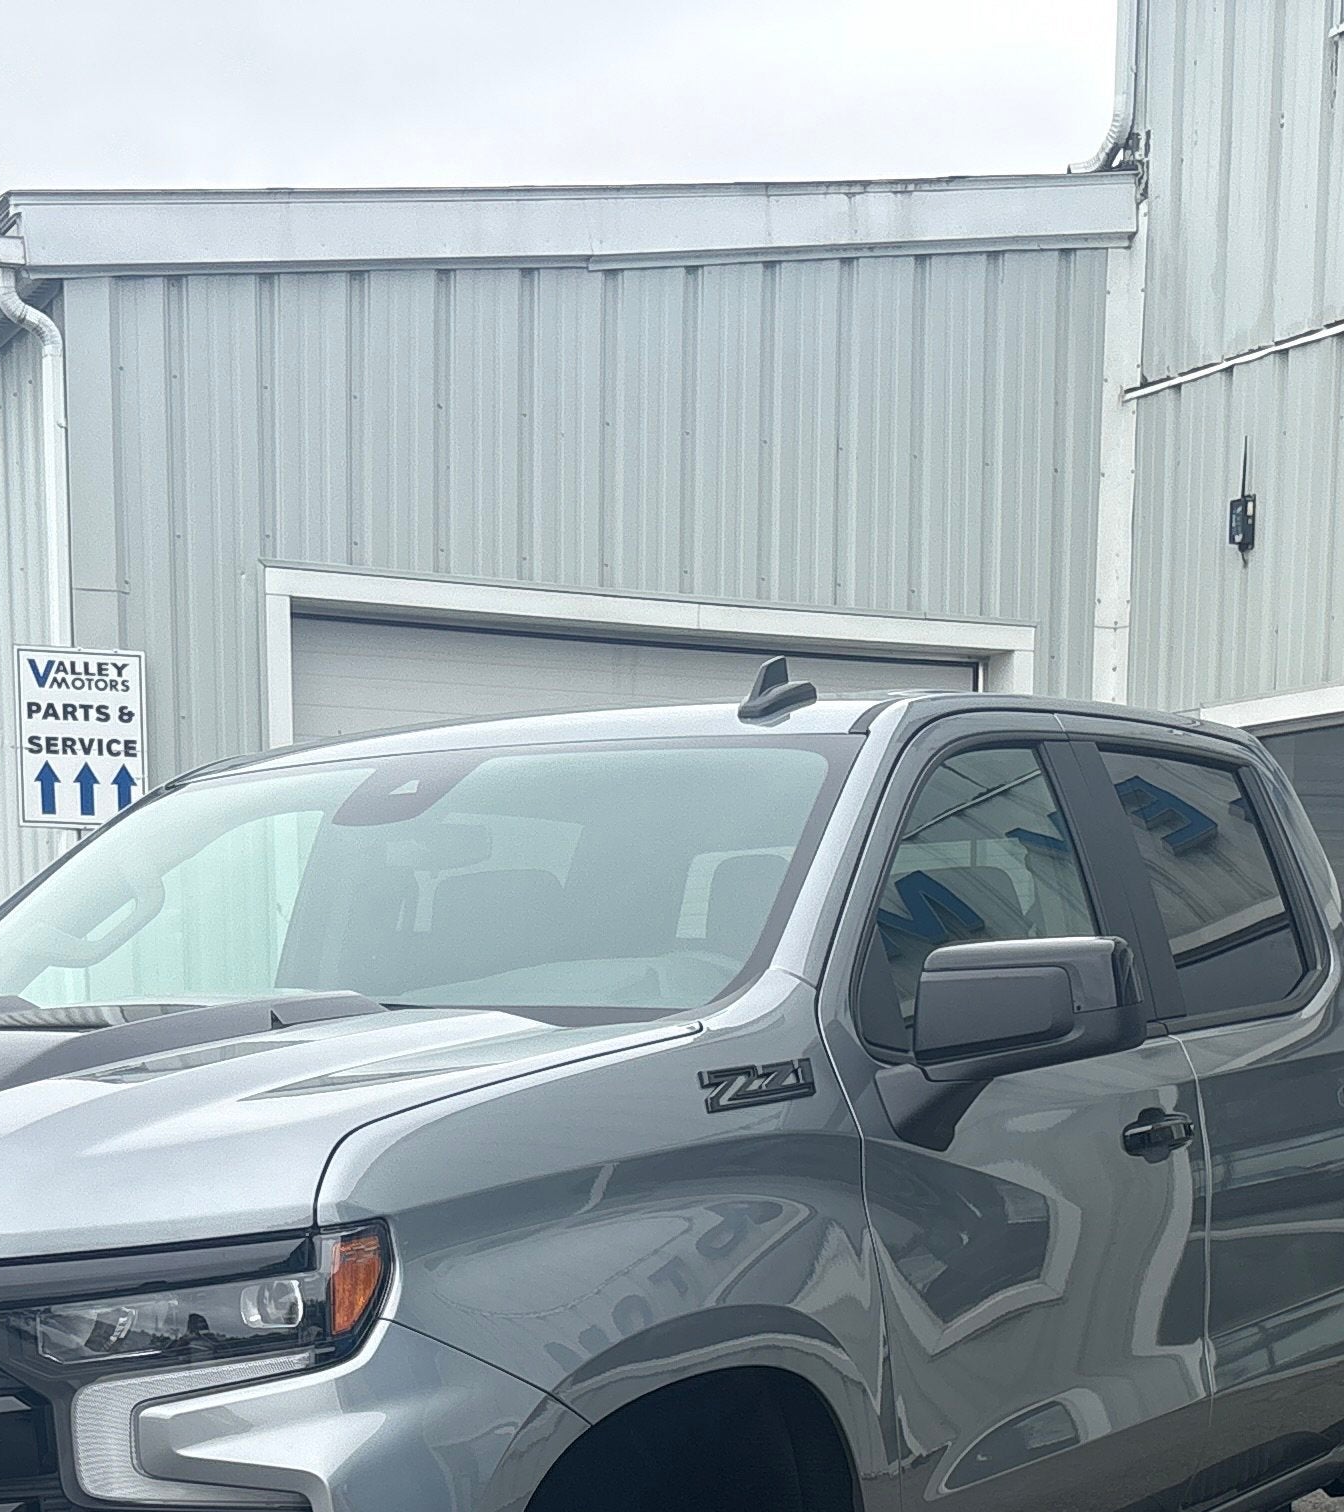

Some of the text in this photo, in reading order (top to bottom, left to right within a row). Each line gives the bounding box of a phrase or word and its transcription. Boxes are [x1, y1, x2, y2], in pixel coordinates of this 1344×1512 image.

[27, 658, 130, 688] VALLEY
[48, 676, 131, 693] MOTORS
[26, 701, 136, 724] PARTS &
[27, 735, 138, 758] SERVICE
[697, 1057, 816, 1114] Z71
